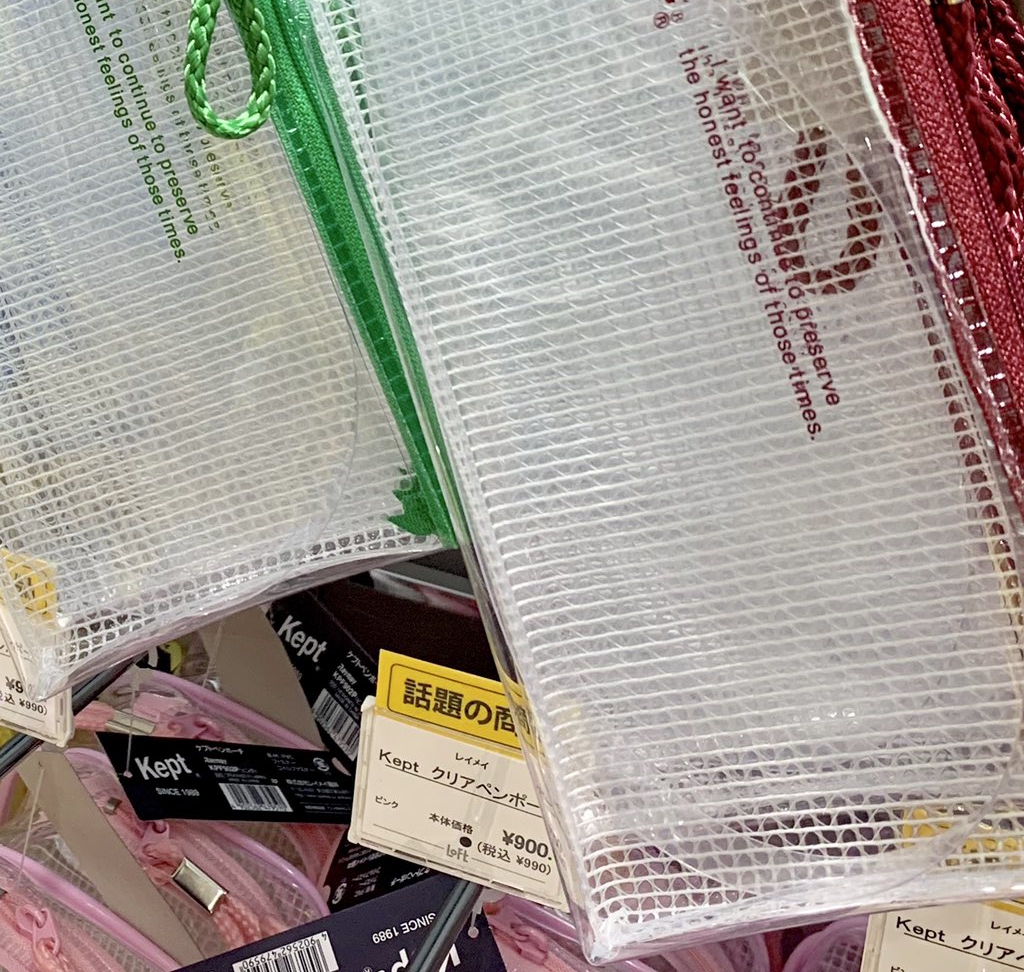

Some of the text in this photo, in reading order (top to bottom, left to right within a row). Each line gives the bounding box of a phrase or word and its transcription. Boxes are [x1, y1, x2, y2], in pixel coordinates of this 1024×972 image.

[108, 28, 123, 48] to
[97, 55, 133, 129] feelings
[118, 52, 157, 132] continue
[715, 73, 748, 131] want
[127, 133, 147, 151] of
[150, 134, 166, 154] to
[737, 140, 756, 164] to
[136, 155, 164, 206] those
[156, 158, 199, 236] preserve
[158, 208, 186, 264] times.
[678, 47, 822, 441] the honest feelings of those times.
[784, 277, 805, 300] to
[790, 307, 841, 407] preserve
[276, 614, 328, 664] Kept
[18, 697, 49, 716] ¥990)
[134, 753, 193, 781] Kept
[378, 749, 420, 774] Kept
[455, 751, 490, 771] レイメイ
[155, 787, 180, 797] SINCE
[375, 794, 399, 809] ピンク
[428, 811, 474, 835] 本体価格
[477, 840, 553, 876] (税込 ¥990)
[372, 927, 400, 945] 1989
[895, 916, 946, 943] Kept
[280, 938, 317, 957] 902562
[242, 951, 277, 970] 479590
